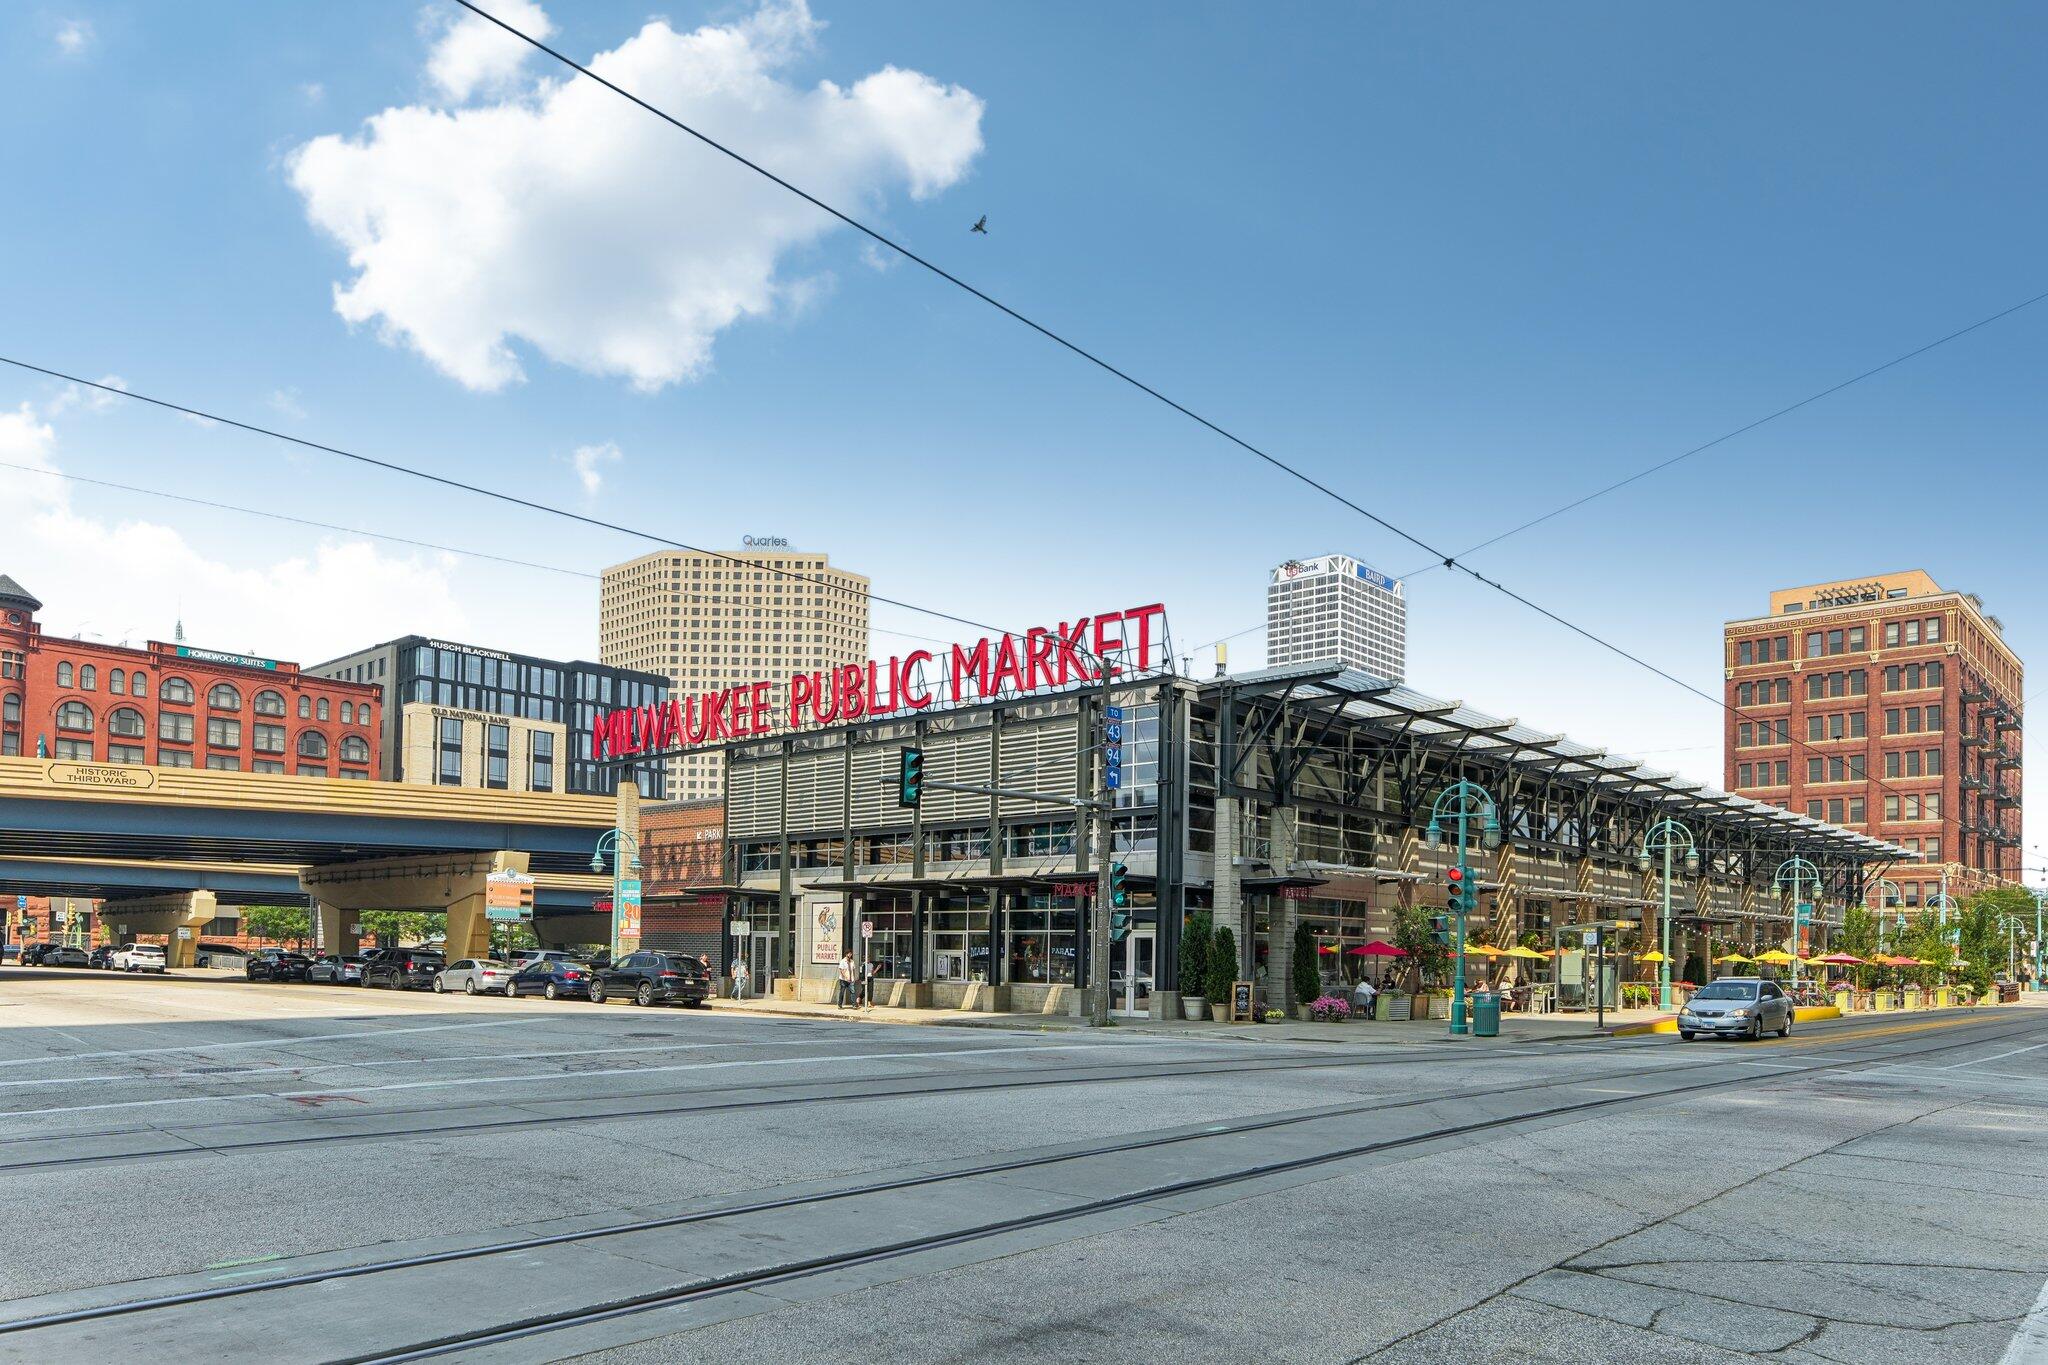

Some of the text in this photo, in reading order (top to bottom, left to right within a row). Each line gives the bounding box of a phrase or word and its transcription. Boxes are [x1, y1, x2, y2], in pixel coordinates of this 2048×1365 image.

[1299, 563, 1319, 573] bank
[1365, 568, 1386, 585] BAIRD
[187, 649, 266, 668] HOMEWOOD SUITES
[430, 641, 511, 661] HUSCH BLACKWELL
[593, 602, 1165, 759] MILWAUKEE PUBLIC MARKET
[431, 707, 510, 725] OLD NATIONAL BANK
[1110, 708, 1119, 717] TO
[1107, 724, 1120, 739] 43
[1107, 748, 1120, 763] 94
[67, 774, 137, 785] THIRD WARD
[76, 768, 127, 778] HISTORIC
[1054, 882, 1097, 897] MARKE
[816, 943, 837, 951] PUBLIC
[815, 952, 838, 960] MARKET
